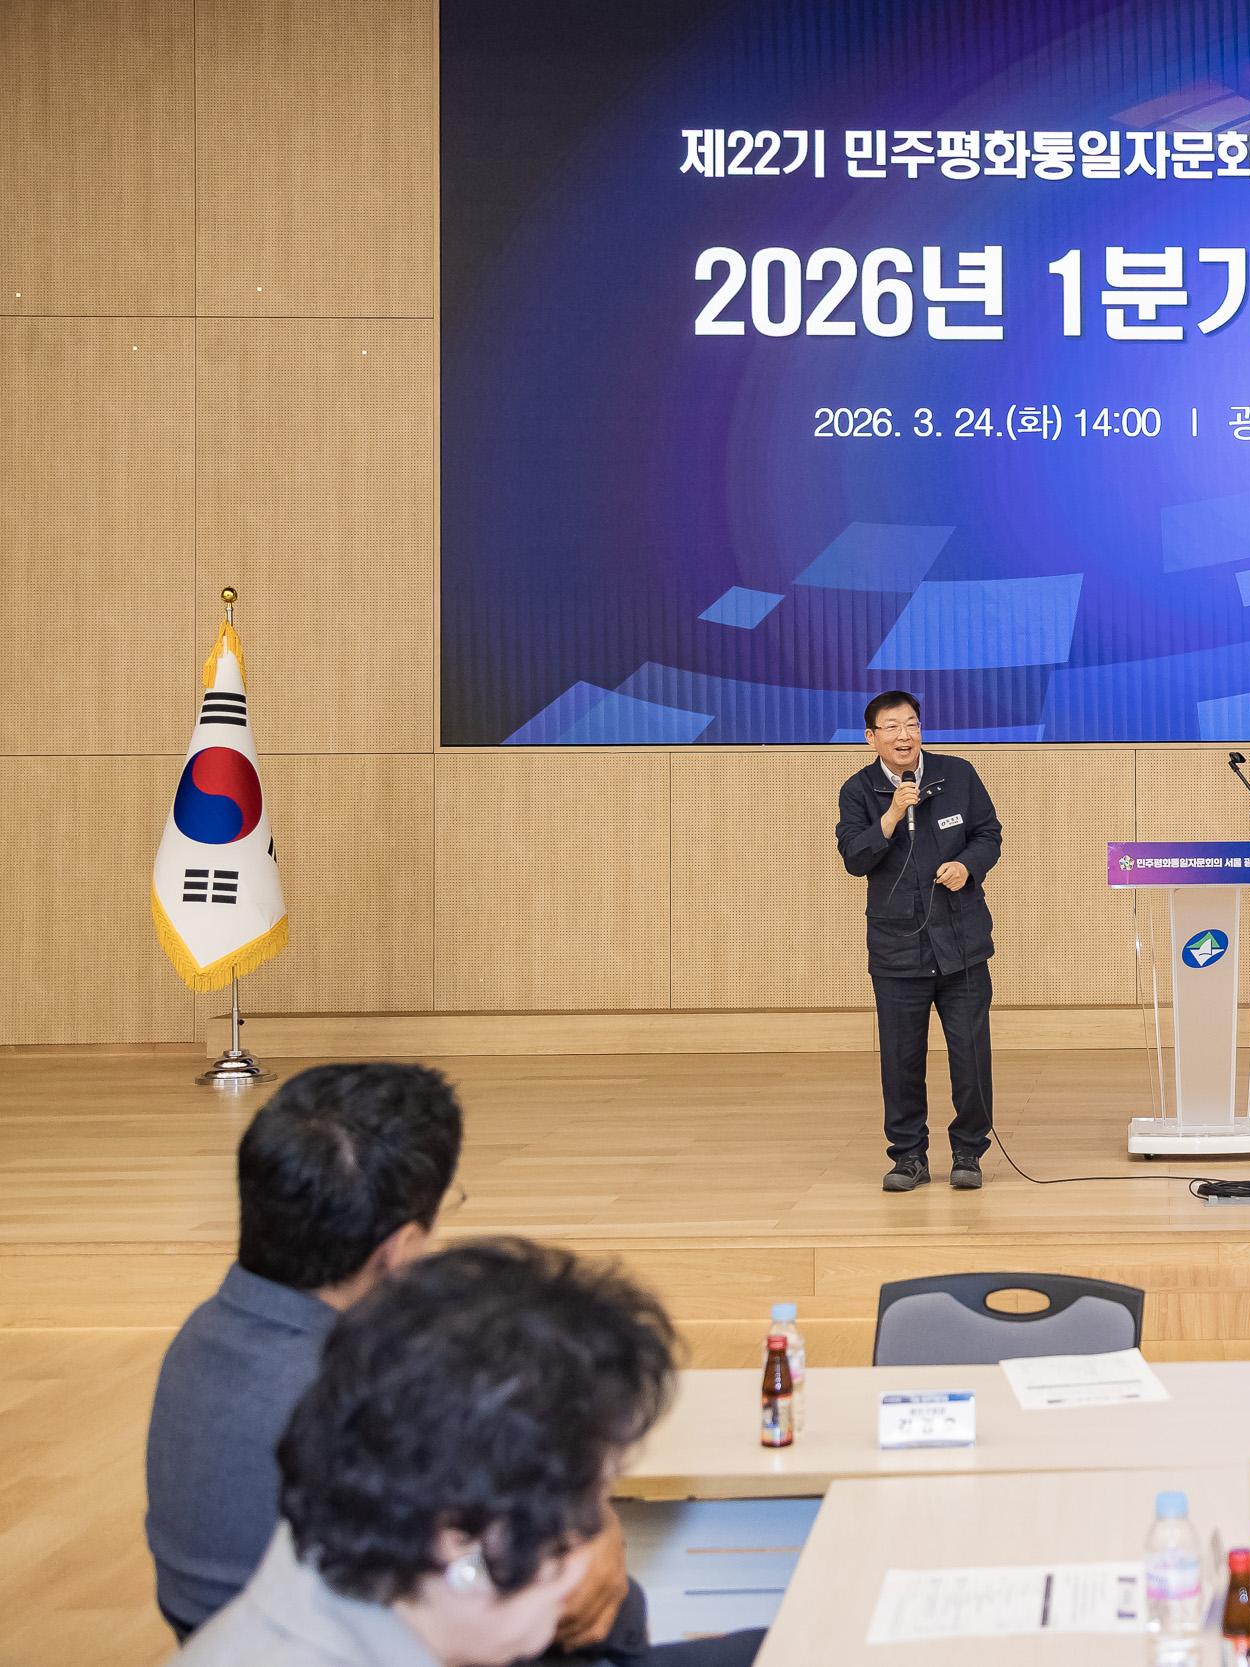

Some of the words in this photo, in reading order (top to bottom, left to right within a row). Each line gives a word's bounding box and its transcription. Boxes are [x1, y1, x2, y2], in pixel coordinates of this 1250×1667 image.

[679, 129, 825, 178] 제22기
[694, 244, 1004, 342] 2026년
[814, 407, 901, 438] 2026.
[913, 407, 942, 438] 3.
[954, 404, 1062, 442] 24.(화)
[1074, 407, 1161, 438] 14:00
[1136, 857, 1223, 869] 민주평화통일자문회의
[1224, 857, 1242, 868] 서울
